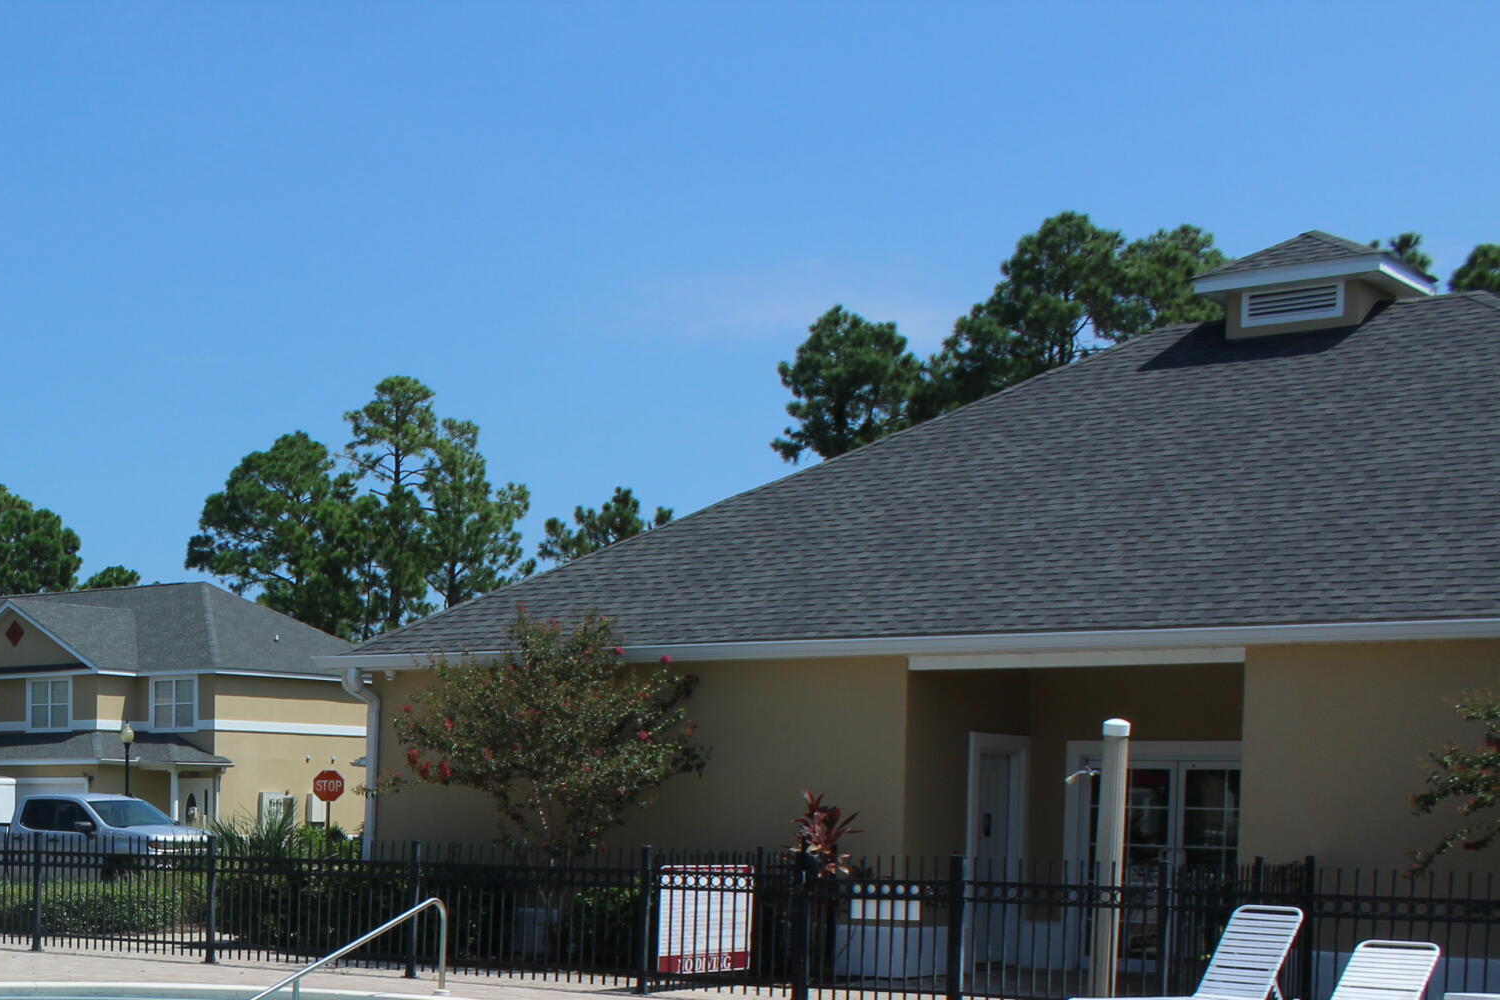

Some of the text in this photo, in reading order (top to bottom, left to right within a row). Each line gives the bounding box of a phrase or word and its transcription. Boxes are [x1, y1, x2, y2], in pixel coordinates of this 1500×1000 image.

[316, 780, 342, 792] STOP
[677, 957, 693, 972] NO
[695, 955, 732, 972] DIVING
